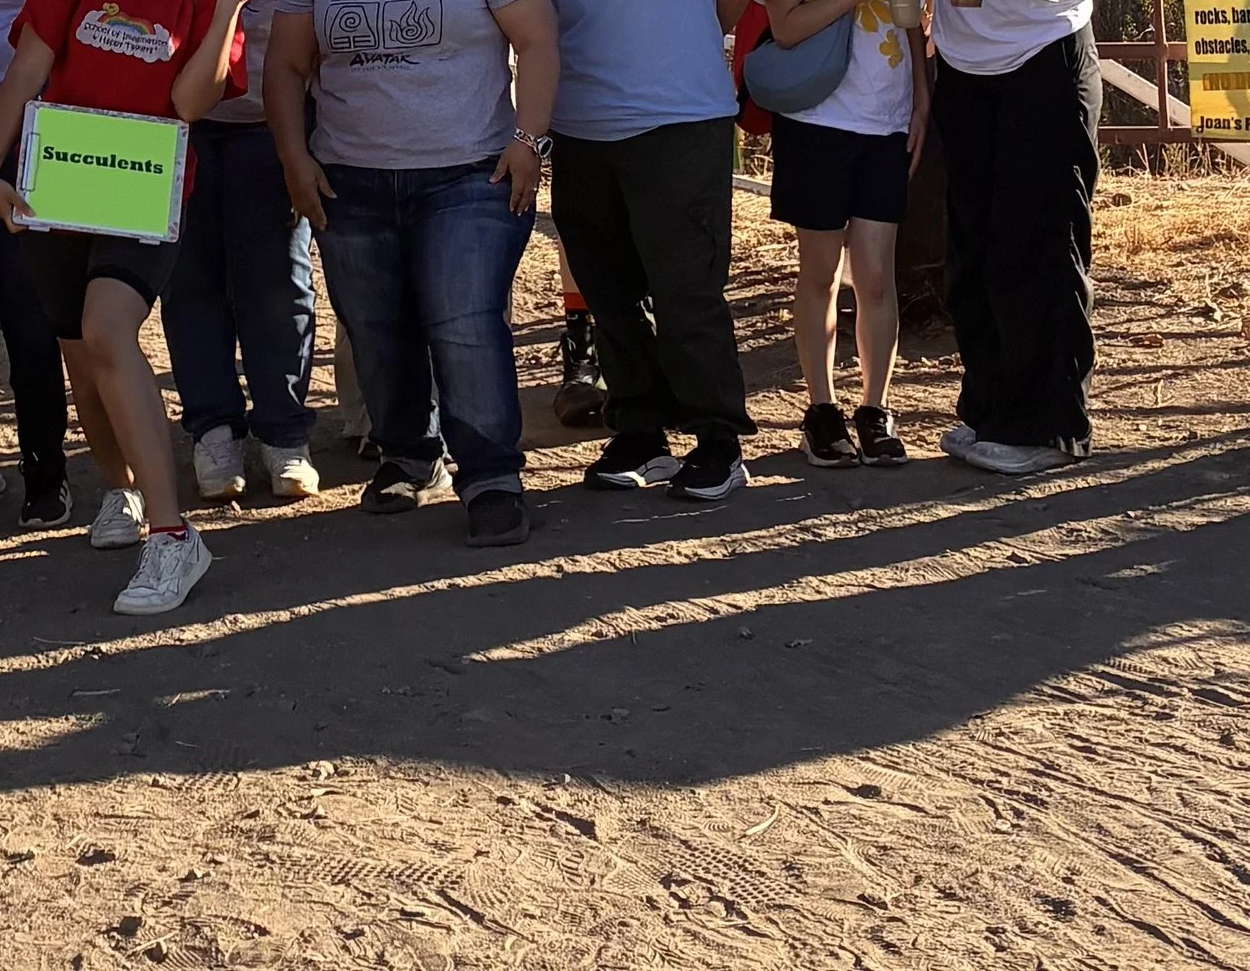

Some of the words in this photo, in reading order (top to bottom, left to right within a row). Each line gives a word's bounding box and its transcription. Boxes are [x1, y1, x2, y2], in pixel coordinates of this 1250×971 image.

[1195, 7, 1231, 25] rocks,
[1195, 36, 1250, 55] obstacles,
[1196, 116, 1242, 133] Joan's
[43, 146, 163, 174] Succulents
